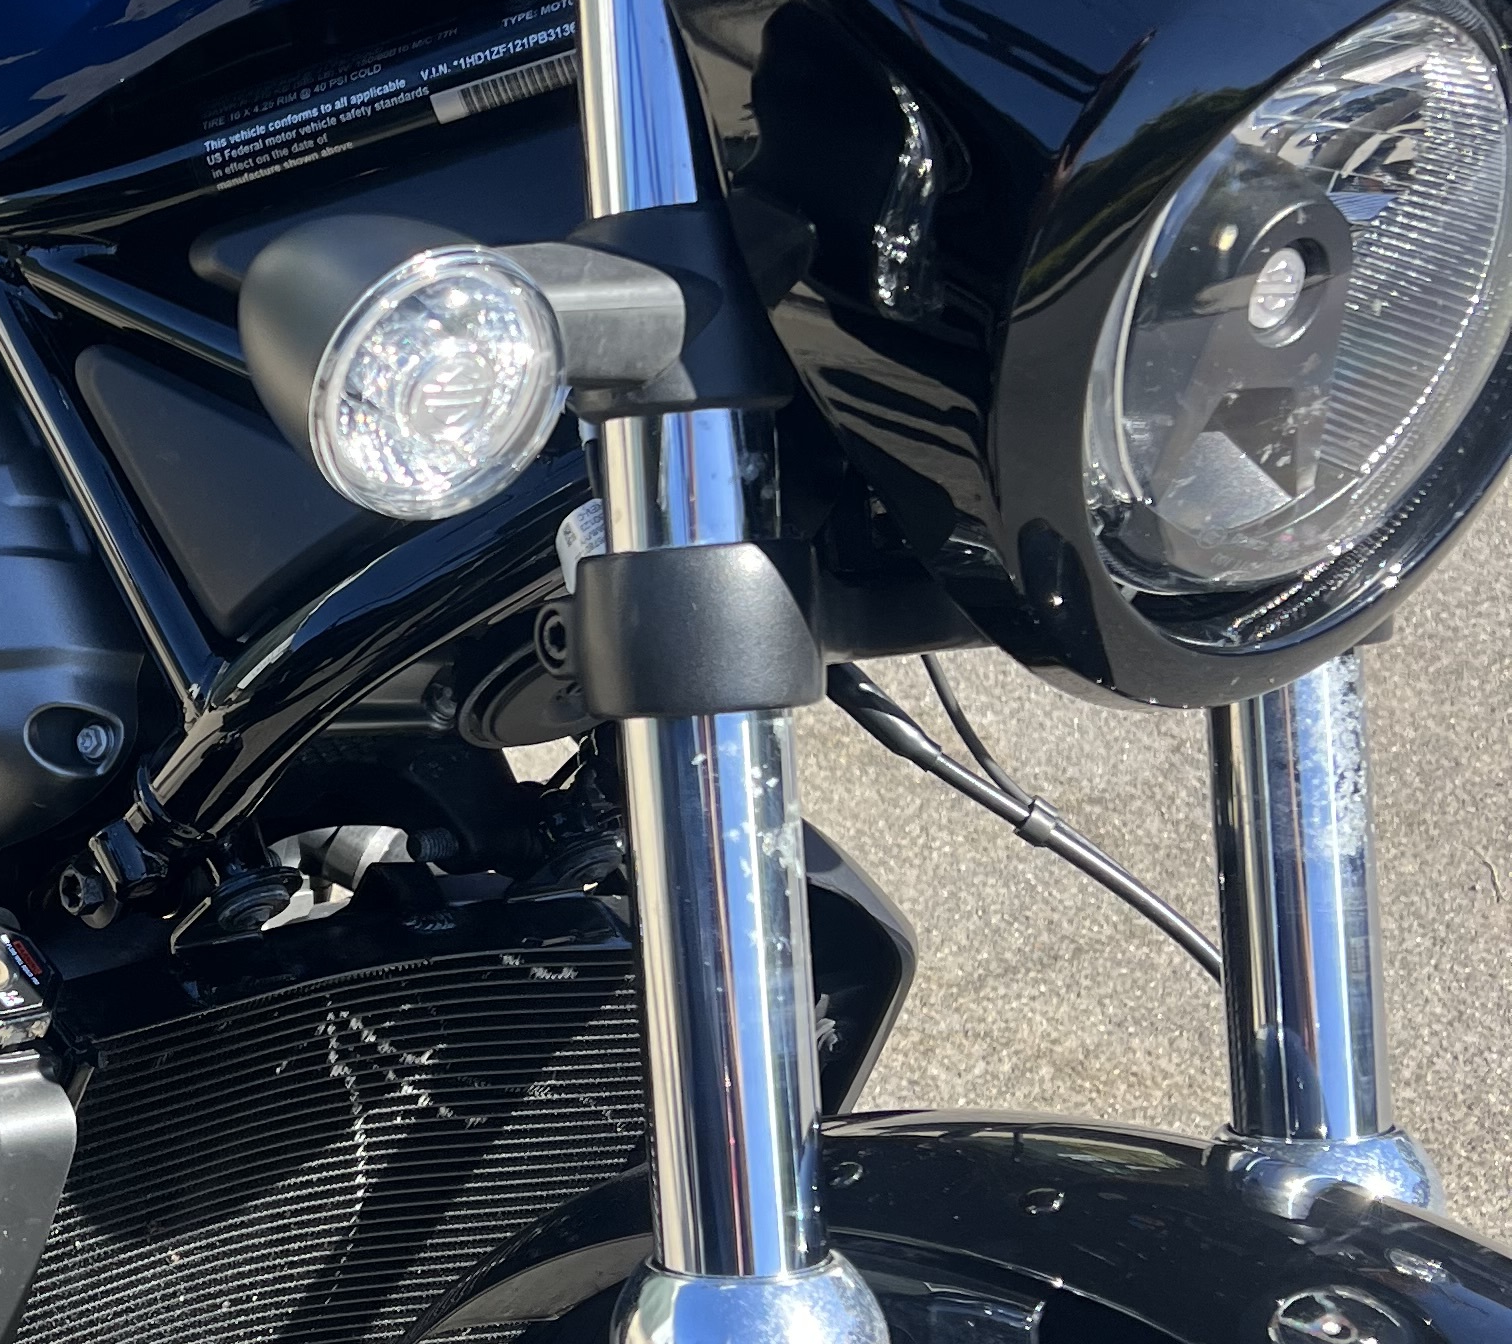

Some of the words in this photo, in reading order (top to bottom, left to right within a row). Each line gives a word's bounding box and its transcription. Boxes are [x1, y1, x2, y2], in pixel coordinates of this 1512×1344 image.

[501, 9, 537, 27] TYPE:
[275, 91, 298, 106] RIM
[312, 82, 326, 93] 40
[328, 74, 349, 88] PSI
[348, 62, 383, 81] COLD
[419, 61, 452, 81] V.I.N.
[203, 135, 227, 153] This
[227, 123, 266, 144] vehicle
[266, 106, 319, 132] conforms
[319, 102, 332, 114] to
[332, 95, 348, 109] all
[347, 76, 407, 106] applicable
[206, 152, 222, 166] US
[223, 138, 264, 159] Federal
[264, 128, 297, 146] motor
[297, 114, 337, 135] vehicle
[337, 102, 373, 124] safety
[372, 84, 430, 111] standards
[211, 167, 223, 178] in
[223, 156, 254, 174] effect
[254, 152, 270, 164] on
[270, 145, 289, 159] the
[289, 137, 314, 153] date
[315, 132, 329, 144] of
[216, 162, 282, 191] manufacture
[282, 150, 319, 169] shown
[320, 139, 353, 157] above
